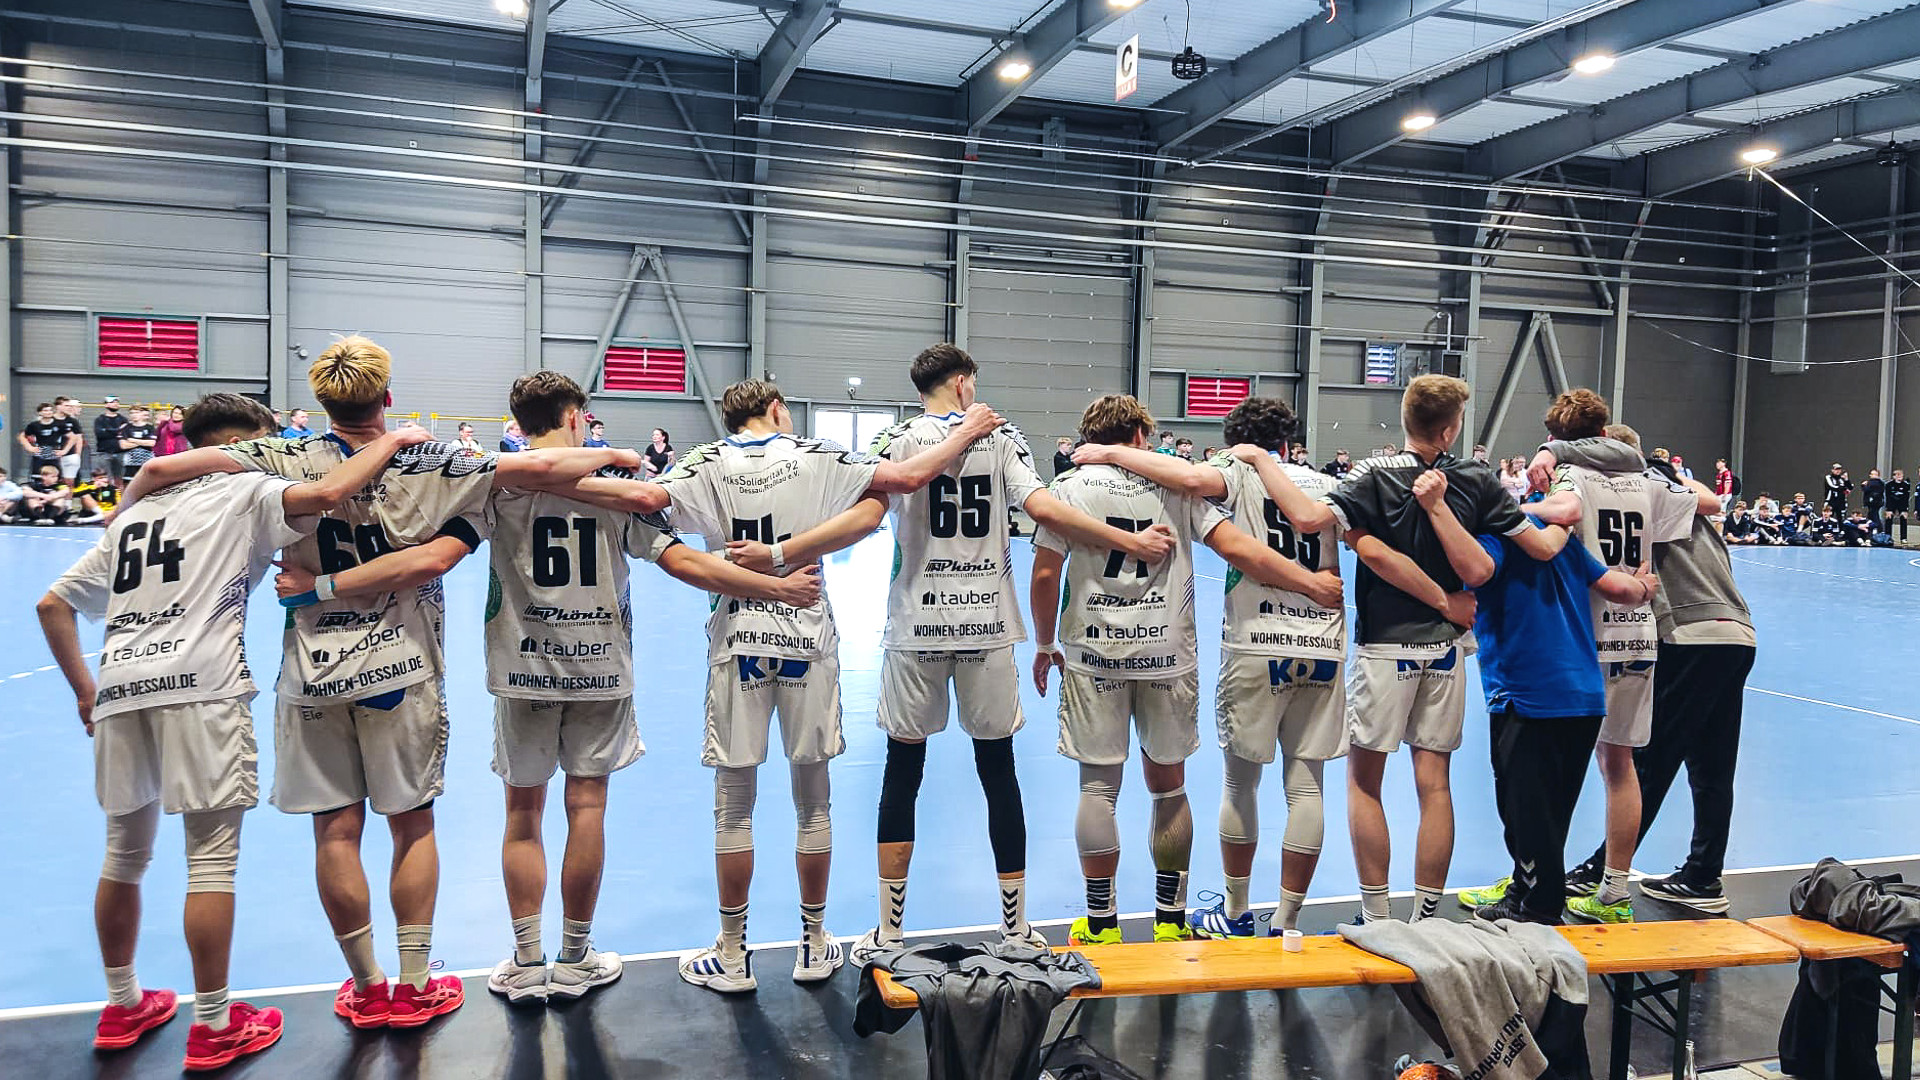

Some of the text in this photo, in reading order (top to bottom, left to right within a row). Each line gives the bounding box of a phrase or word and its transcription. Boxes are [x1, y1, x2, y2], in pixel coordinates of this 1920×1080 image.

[1121, 44, 1132, 77] C
[785, 459, 799, 473] 92
[929, 474, 992, 539] 65
[1598, 508, 1643, 568] 56
[112, 517, 185, 595] 64
[532, 516, 597, 588] 61
[924, 558, 997, 573] Phönix
[939, 589, 1000, 606] tauber
[1086, 591, 1166, 607] Phönix
[523, 602, 613, 621] Phönix
[744, 597, 800, 619] tauber
[1278, 601, 1337, 621] tauber
[913, 620, 1006, 637] WOHNEN-DESSAU.DE
[1104, 623, 1169, 640] tauber
[338, 623, 405, 662] tuber
[542, 638, 613, 657] tauber
[1250, 631, 1342, 652] WOHNEN-DESSAU.DE
[1080, 650, 1178, 670] WOHNEN-DESSAU.DE
[302, 655, 424, 698] WOHNEN-DESSAU.DE
[508, 671, 620, 690] WOHNEN-DESSAU.DE
[1503, 1033, 1527, 1068] JSPG
